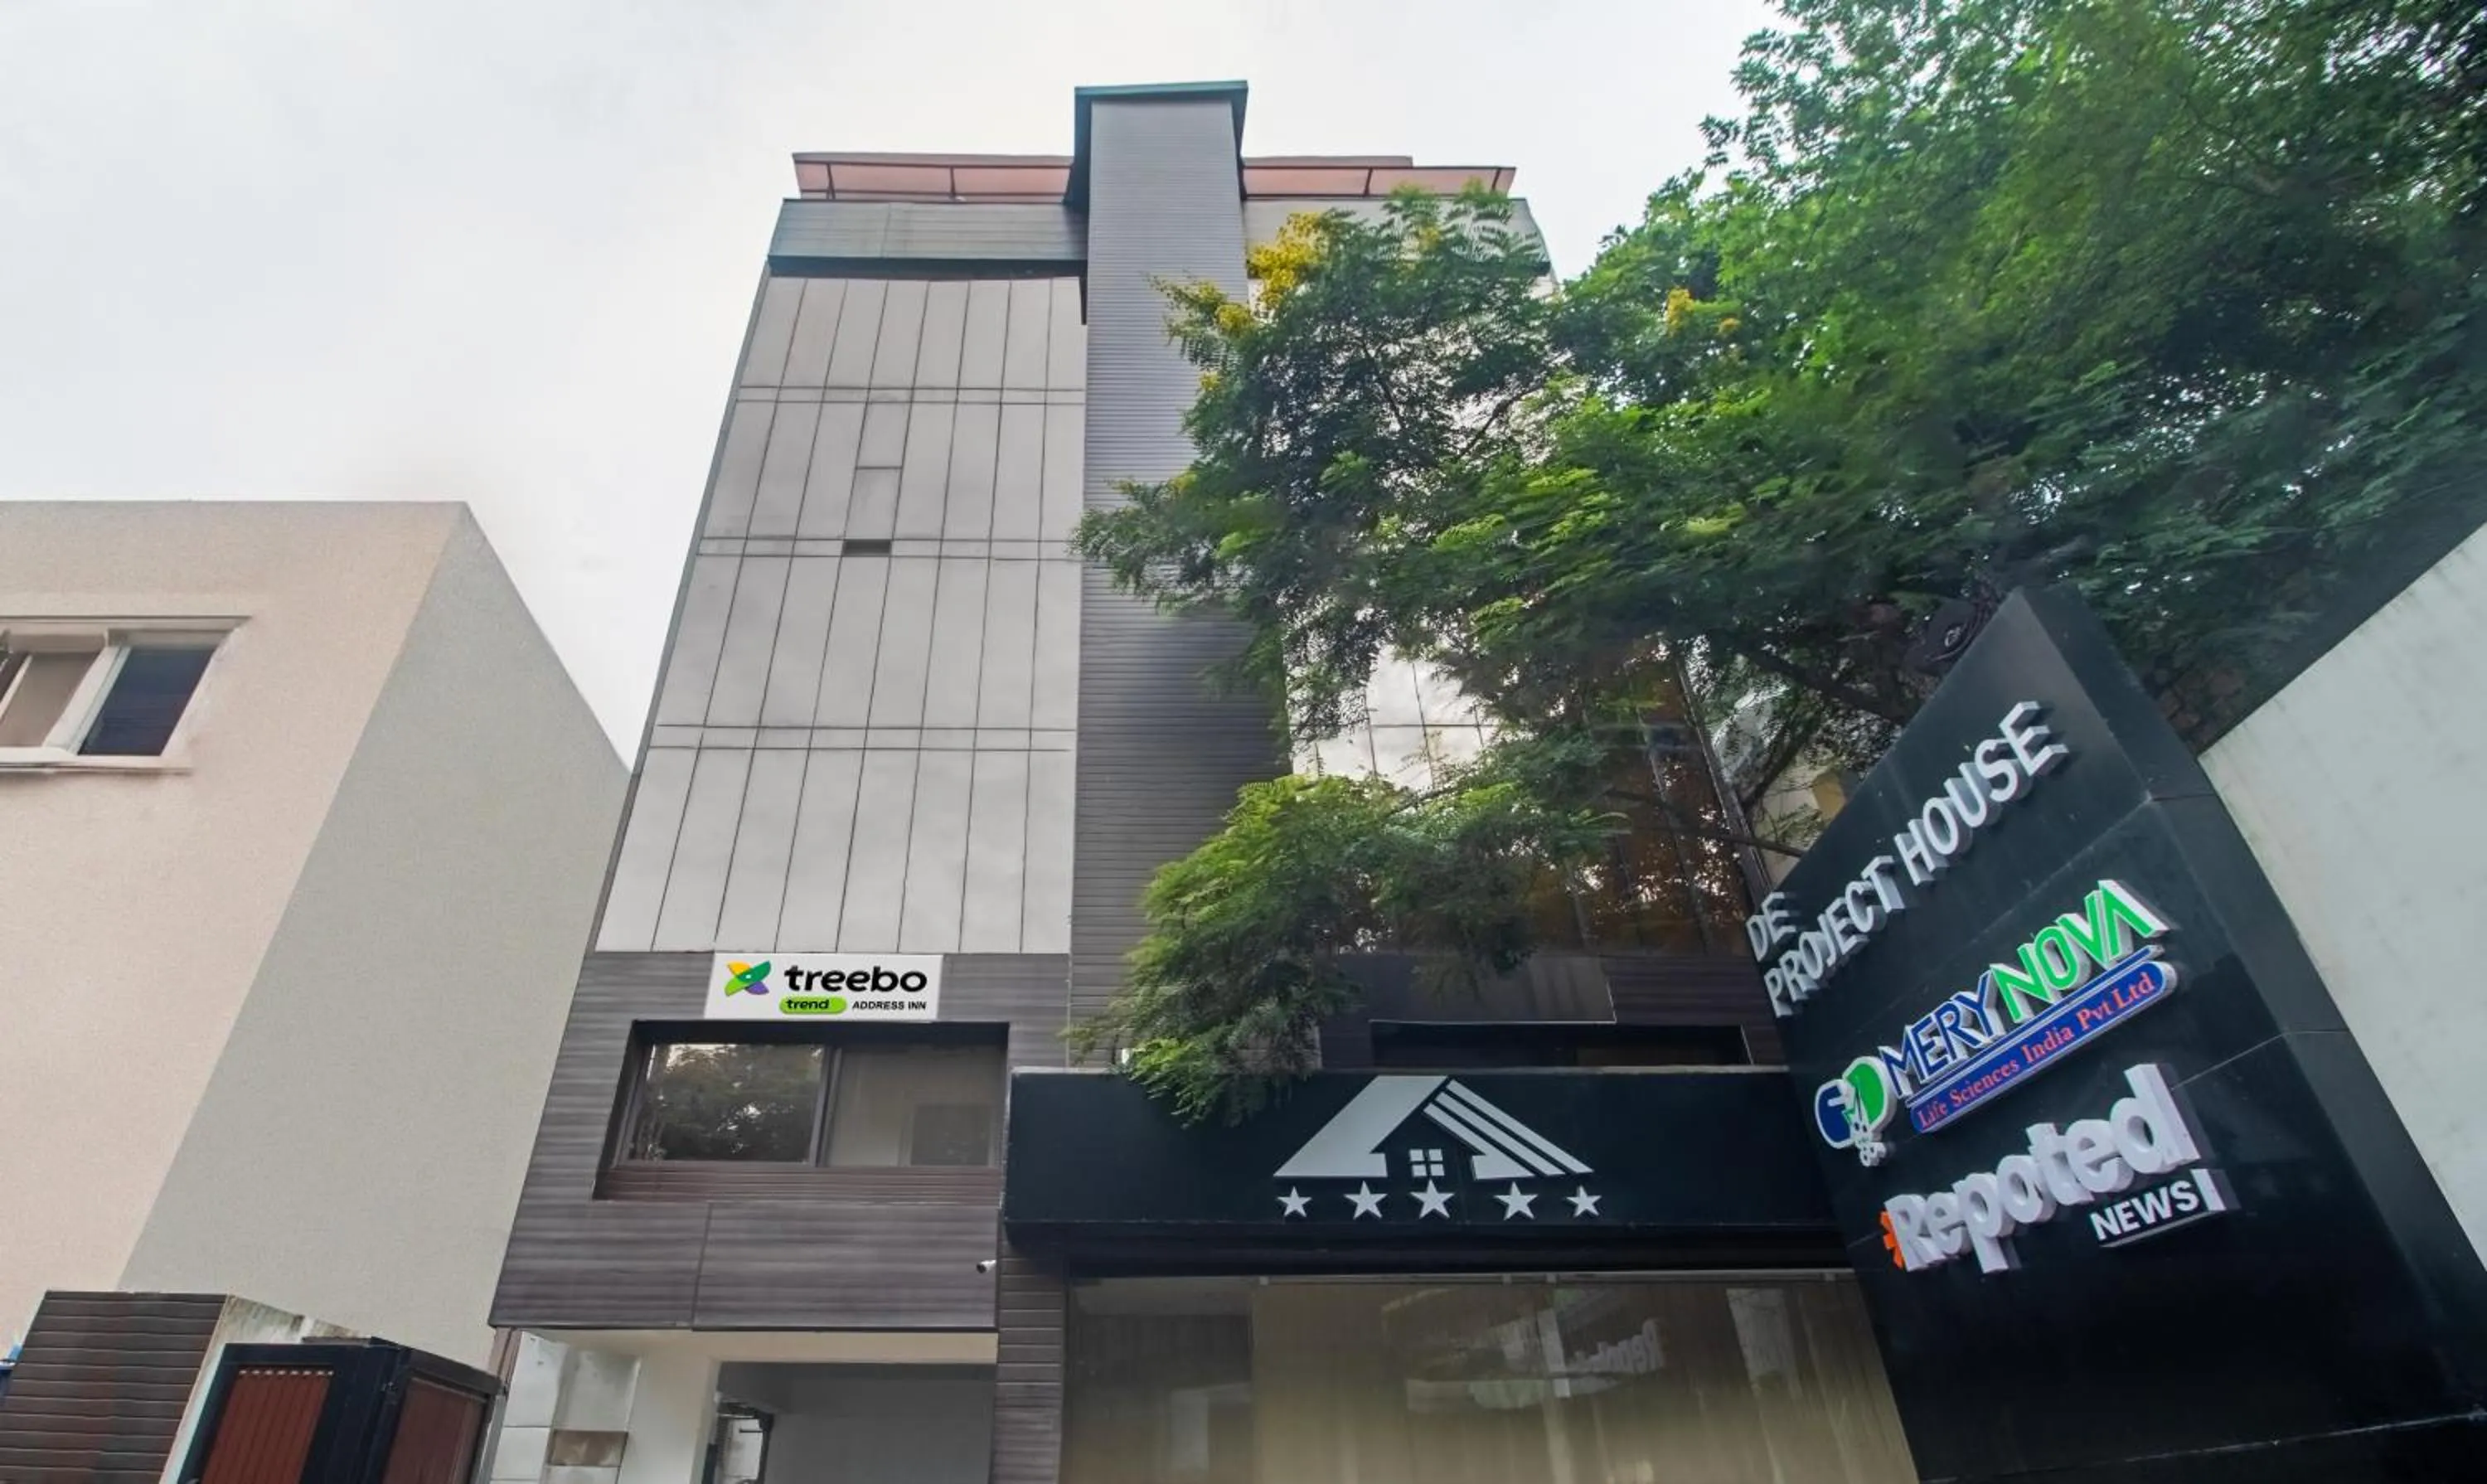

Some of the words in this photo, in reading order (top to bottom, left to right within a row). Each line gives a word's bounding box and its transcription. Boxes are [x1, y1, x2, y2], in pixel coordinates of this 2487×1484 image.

[1763, 855, 1905, 1018] PROJECT
[1893, 701, 2069, 885] HOUSE
[1746, 892, 1796, 963] DE
[784, 965, 927, 992] treebo
[785, 998, 830, 1010] trend
[852, 1001, 905, 1011] ADDRESS
[908, 1001, 927, 1010] INN
[1917, 1101, 1949, 1130] Life
[1950, 1057, 2020, 1108] Sciences
[2021, 1025, 2075, 1065] India
[2076, 1001, 2114, 1031] Pvt
[2111, 971, 2155, 1010] Ltd
[1883, 1064, 2201, 1273] Repoted
[2090, 1181, 2201, 1241] NEWS
